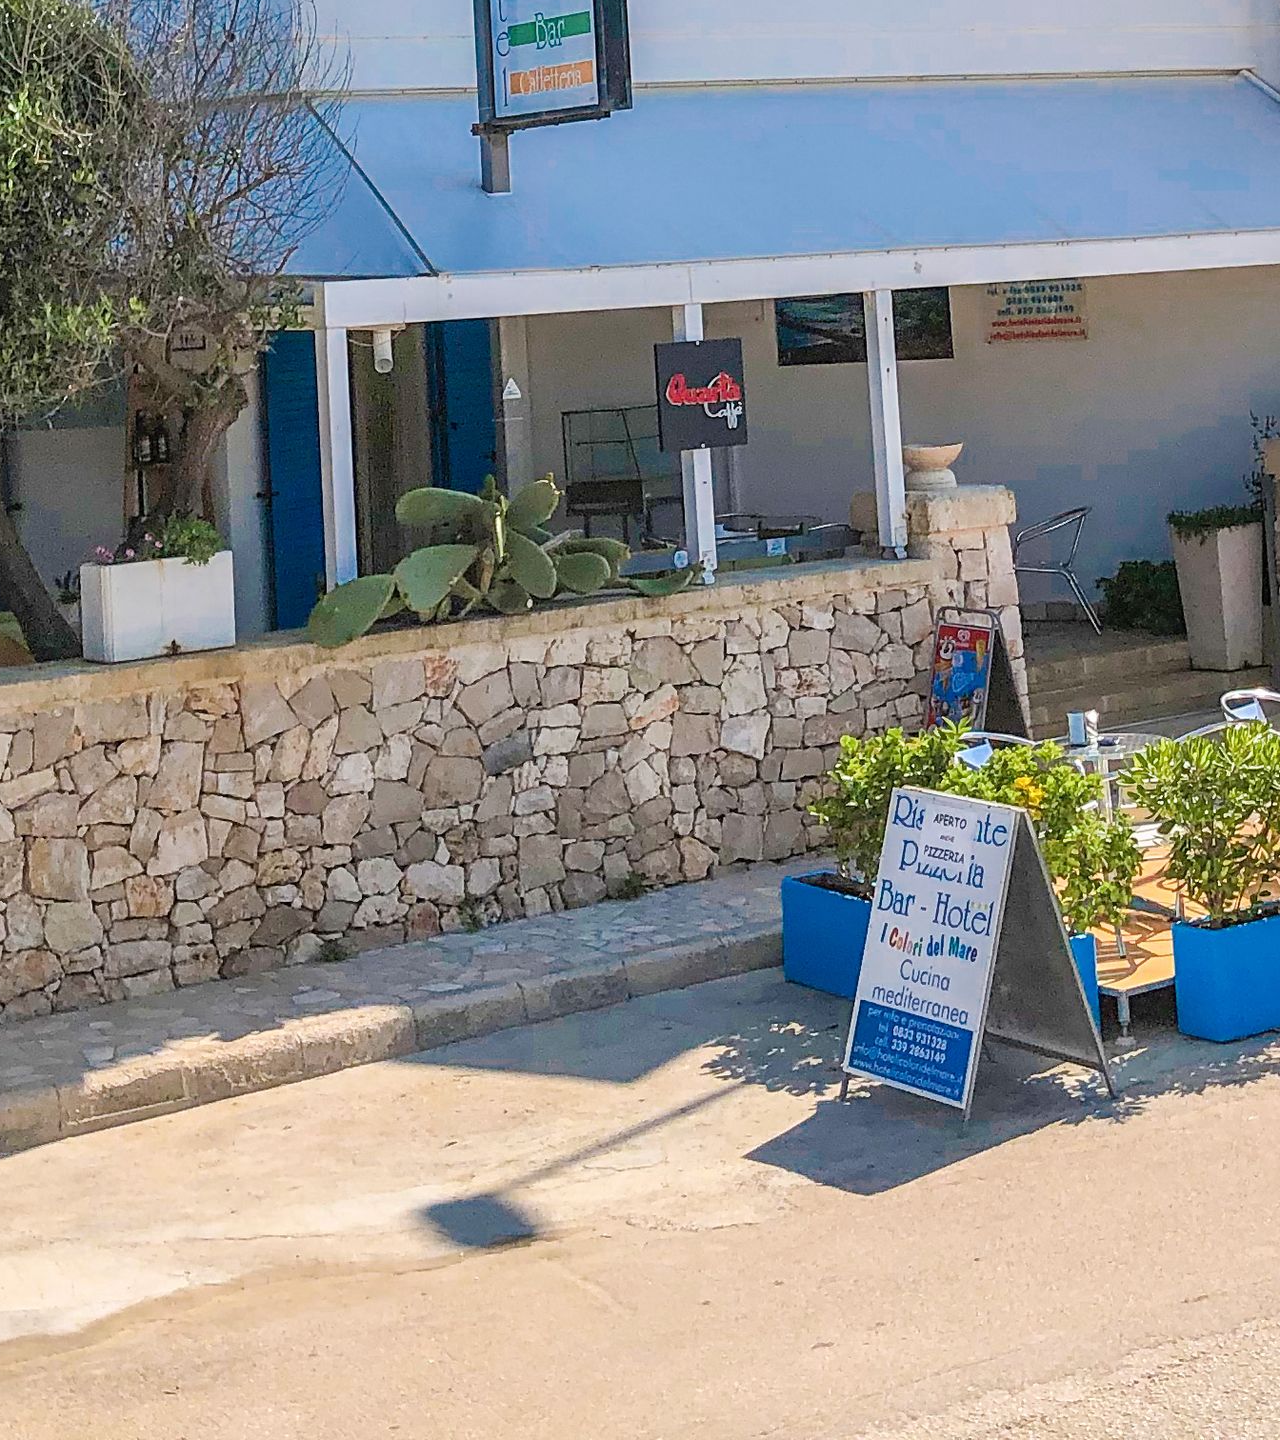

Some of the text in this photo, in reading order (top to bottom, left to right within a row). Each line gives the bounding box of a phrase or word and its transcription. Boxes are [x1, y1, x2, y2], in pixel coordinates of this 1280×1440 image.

[534, 12, 565, 49] Bar
[519, 63, 582, 95] Caffetteria
[933, 813, 967, 830] APERTO
[923, 844, 965, 864] PIZZERIA
[877, 879, 915, 916] Bar
[933, 892, 994, 936] Hotel
[880, 923, 978, 962] I Colori del Mare
[900, 959, 950, 991] Cucina
[872, 985, 969, 1025] mediterranea
[891, 1039, 907, 1052] 339
